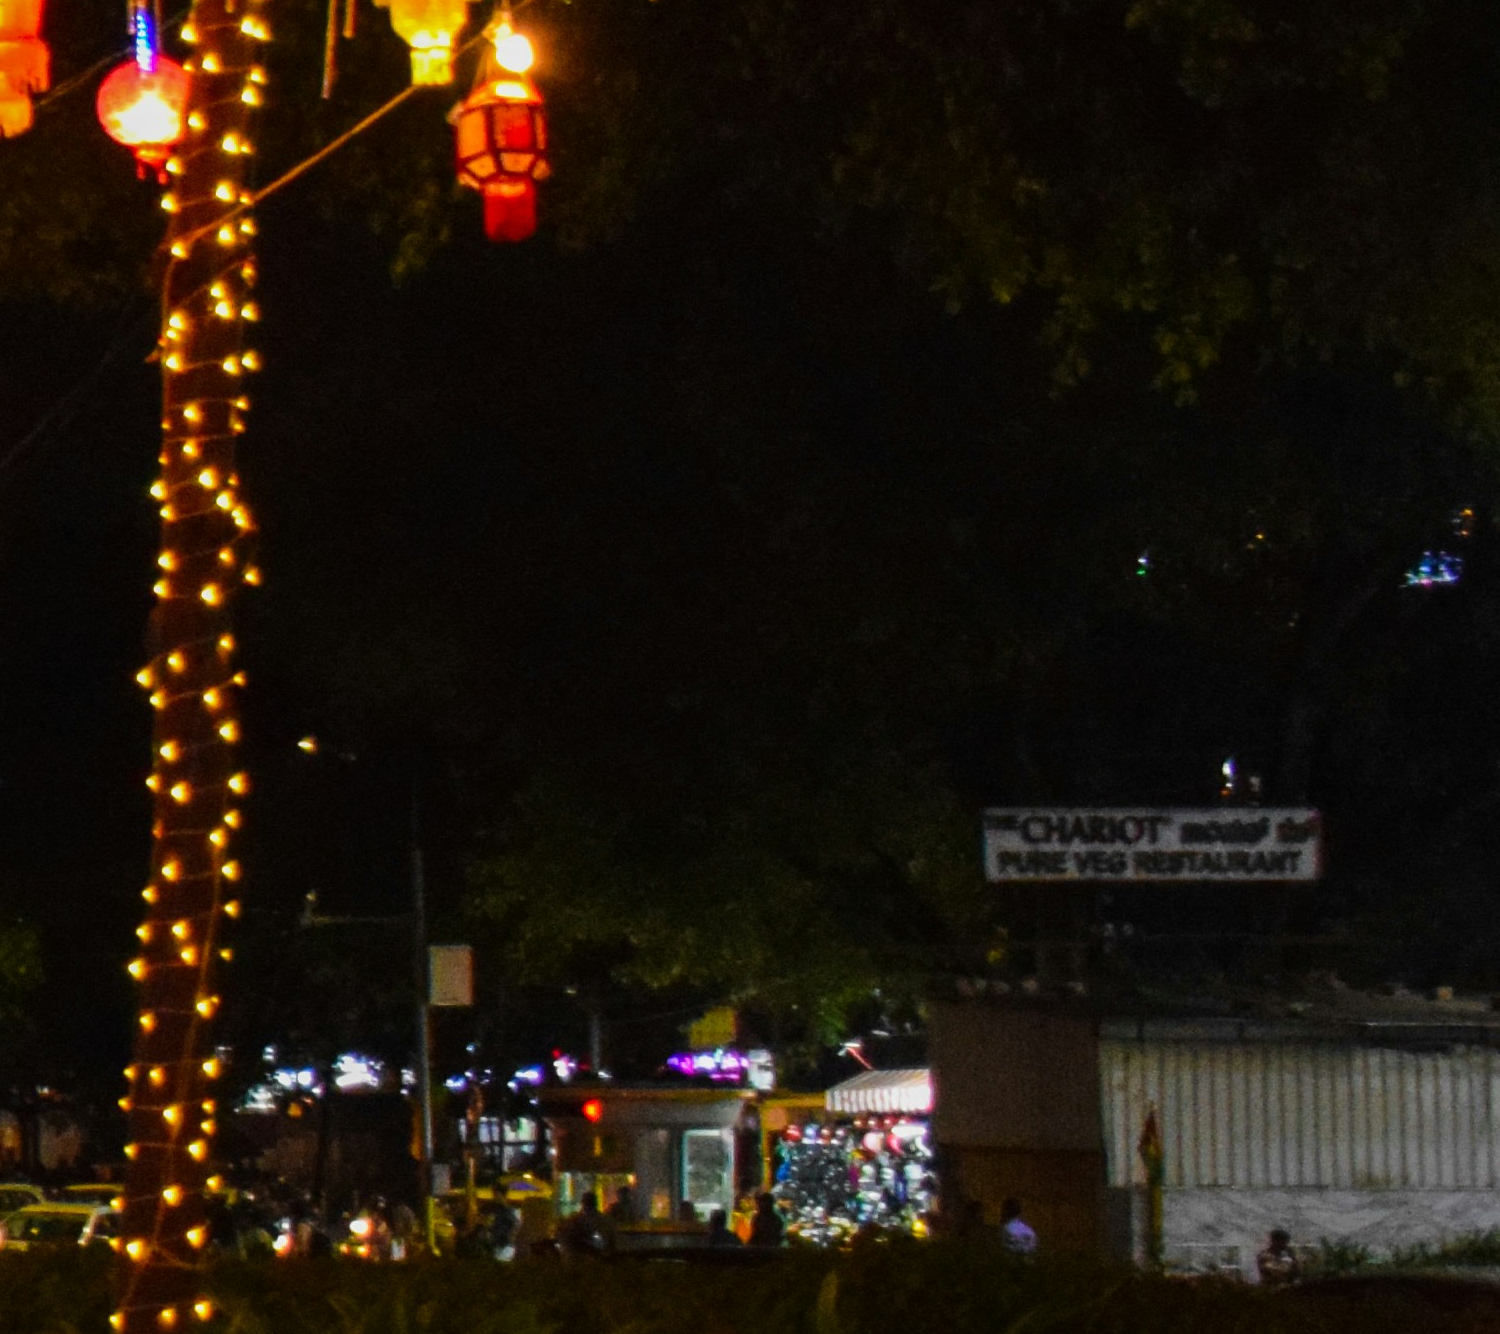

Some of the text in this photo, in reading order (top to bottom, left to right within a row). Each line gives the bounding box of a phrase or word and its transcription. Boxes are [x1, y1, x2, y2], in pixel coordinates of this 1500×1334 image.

[1020, 815, 1166, 844] CHARIOT
[997, 850, 1300, 875] PURE VEG RESTAURANT
